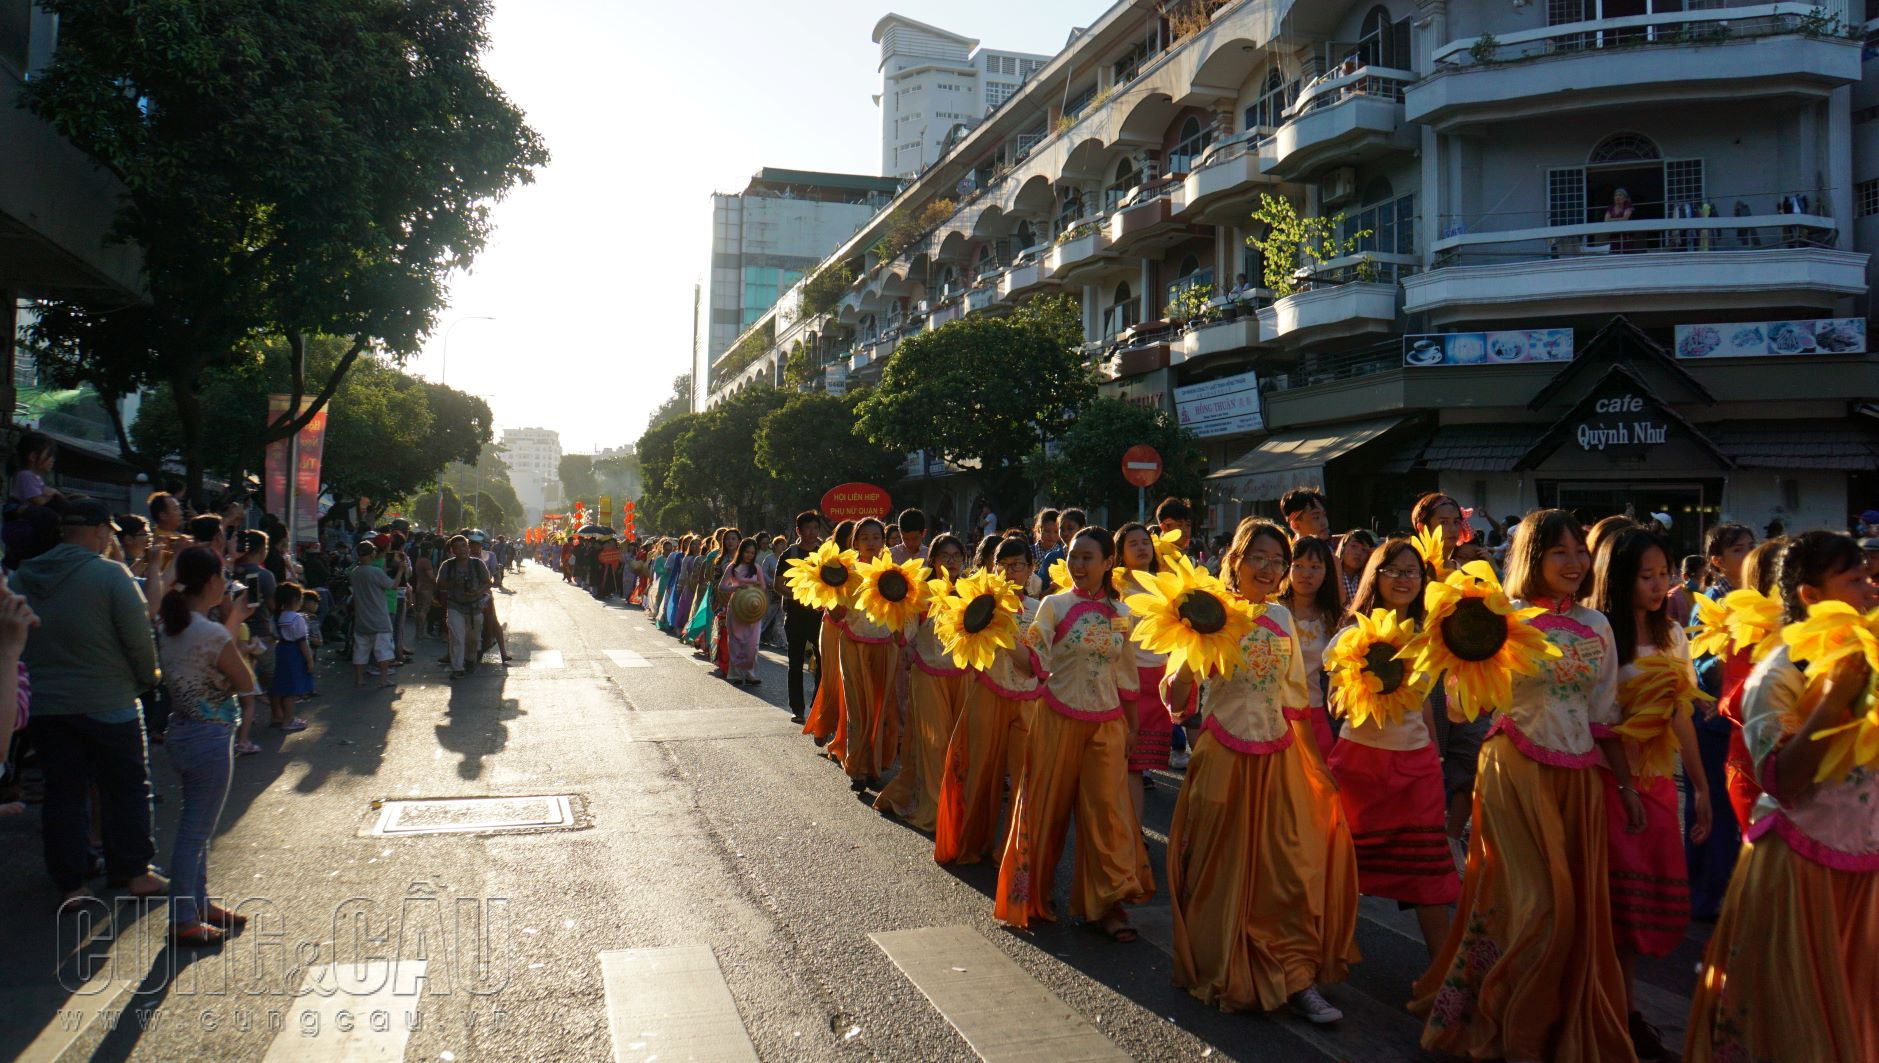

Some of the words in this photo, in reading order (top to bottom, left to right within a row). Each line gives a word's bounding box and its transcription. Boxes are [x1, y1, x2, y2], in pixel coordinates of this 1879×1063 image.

[1595, 394, 1644, 413] cafe
[1577, 422, 1630, 450] Quỳnh
[1632, 422, 1668, 444] Như
[847, 492, 863, 501] LIÊN
[879, 507, 885, 515] 5
